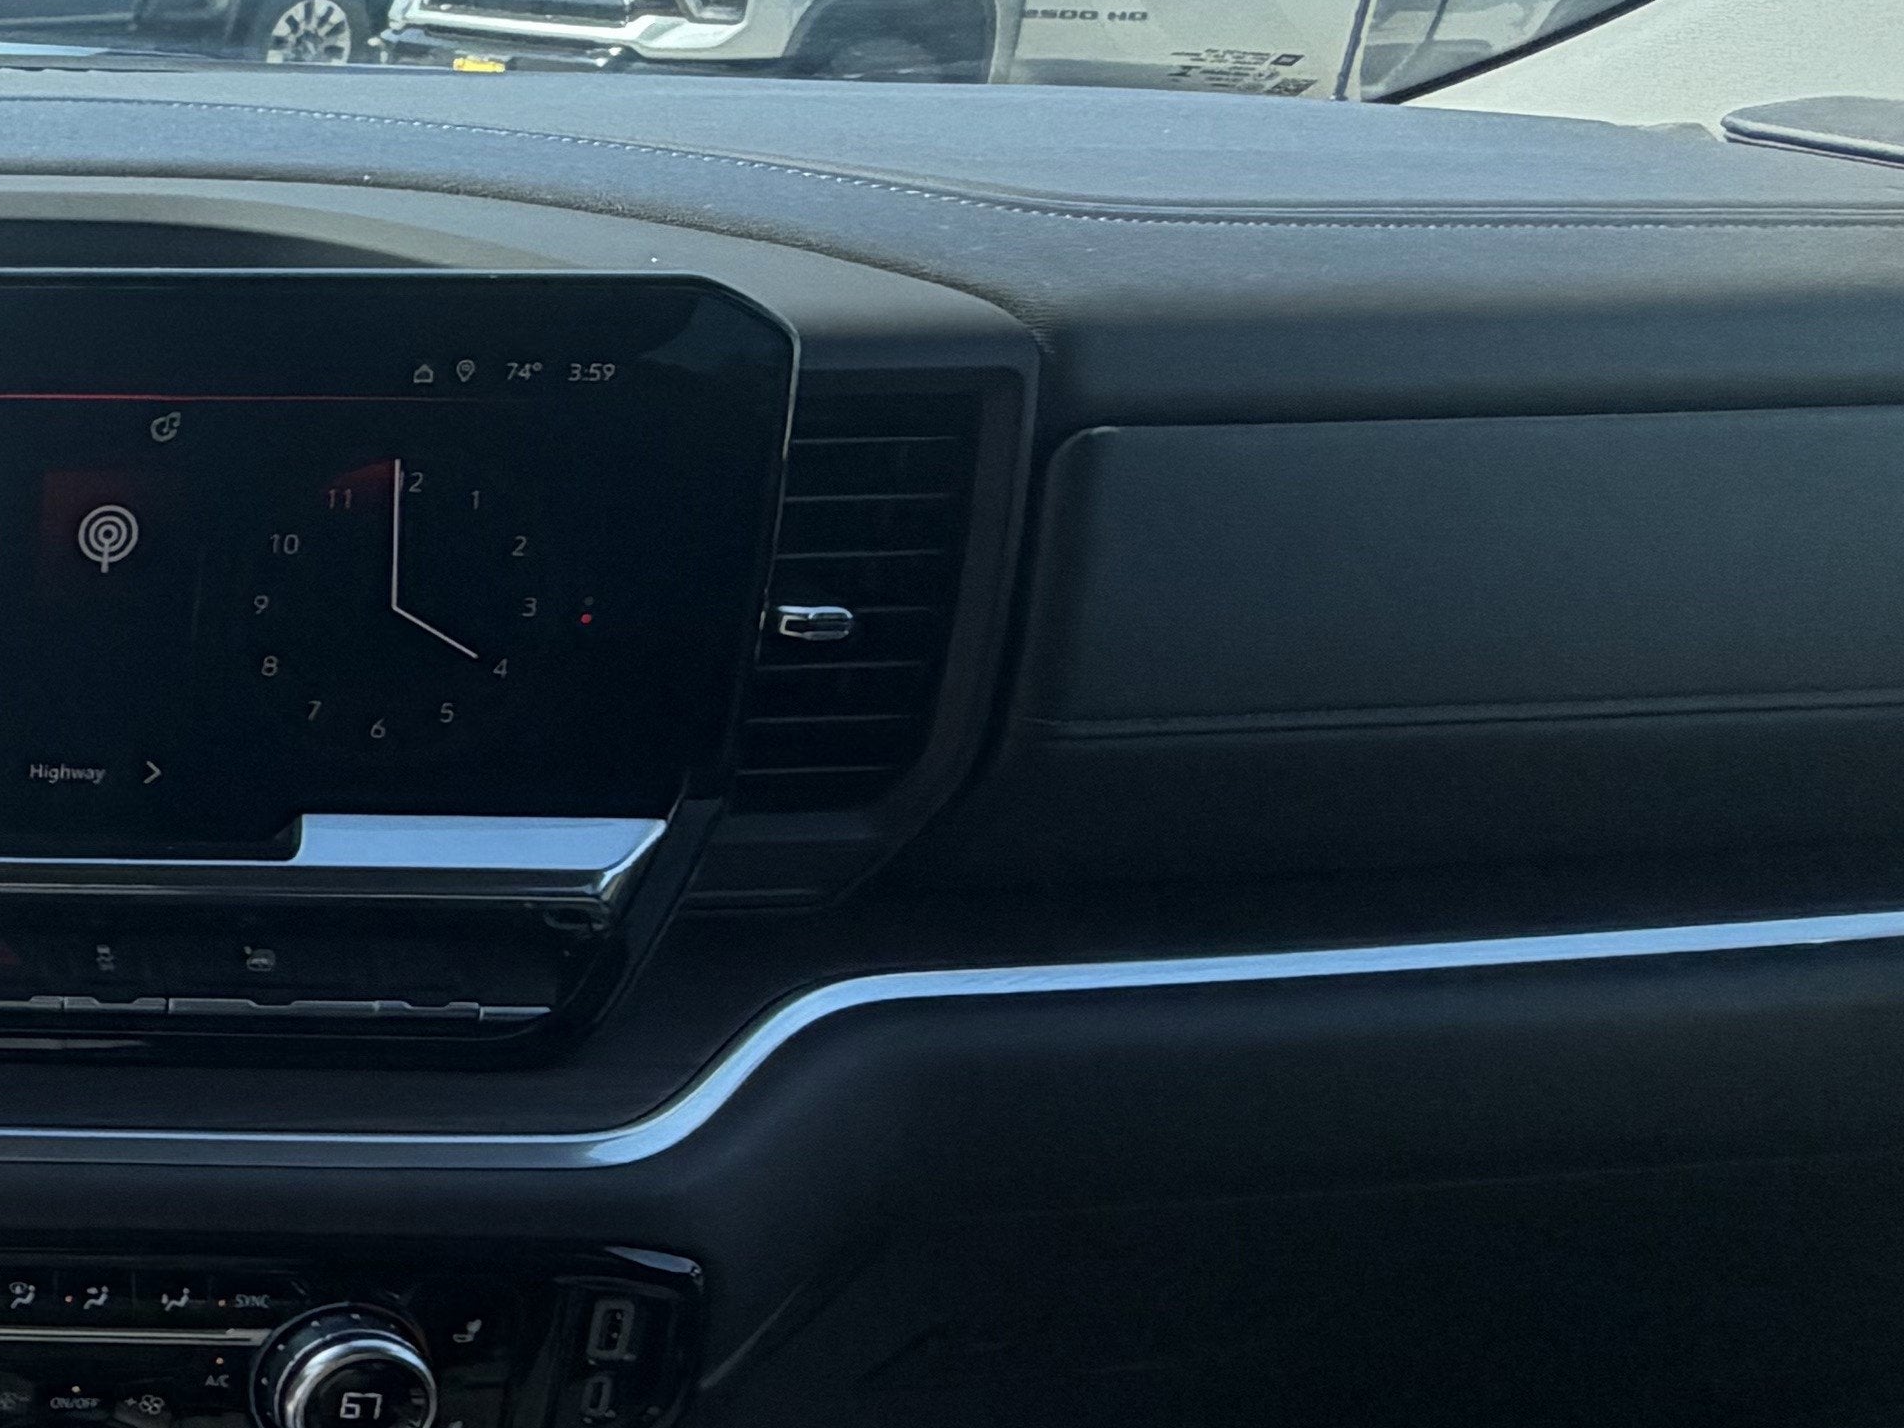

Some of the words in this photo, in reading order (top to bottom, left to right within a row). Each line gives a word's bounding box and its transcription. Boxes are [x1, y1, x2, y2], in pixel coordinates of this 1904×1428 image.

[506, 363, 542, 381] 74°
[568, 363, 615, 382] 3:59
[328, 488, 352, 510] 11
[270, 533, 301, 555] 10
[511, 535, 527, 557] 2
[253, 595, 270, 615] 9
[522, 597, 538, 617] 3
[260, 655, 280, 677] 8
[492, 658, 509, 680] 4
[307, 700, 322, 722] 7
[440, 702, 454, 723] 5
[369, 718, 387, 739] 6
[29, 763, 106, 784] Highway
[234, 1293, 272, 1309] SYNC
[204, 1373, 231, 1388] A/C
[49, 1395, 101, 1409] ON/OFF
[339, 1391, 384, 1421] 67
